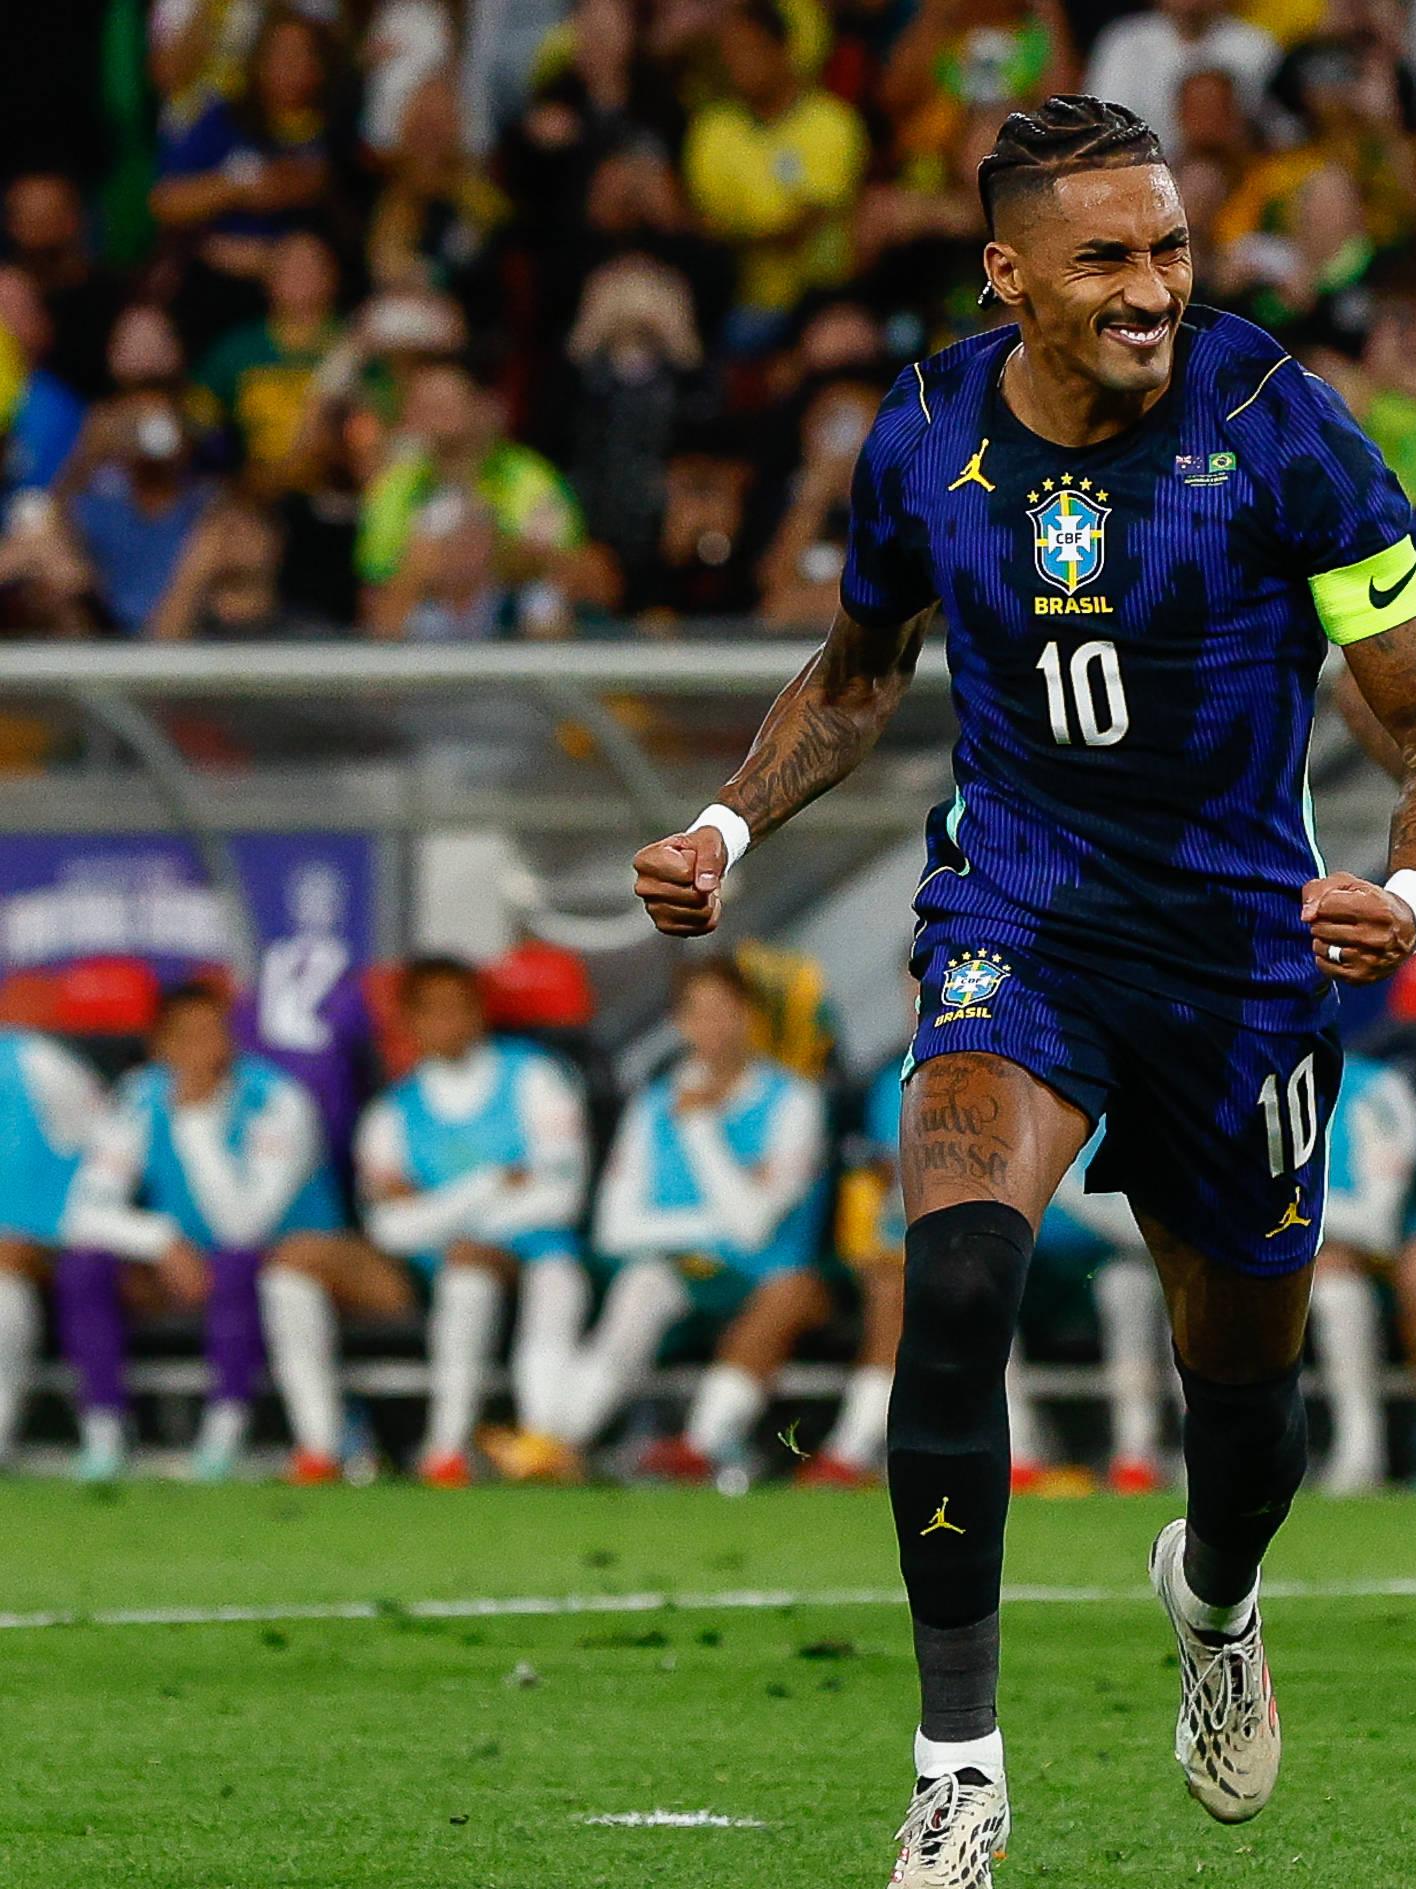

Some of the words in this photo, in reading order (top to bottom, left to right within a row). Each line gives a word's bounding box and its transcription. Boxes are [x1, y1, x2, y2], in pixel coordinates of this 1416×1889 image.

[1056, 532, 1083, 544] CBF
[1034, 596, 1114, 615] BRASIL
[1035, 640, 1129, 746] 10
[934, 1006, 992, 1028] BRASIL
[1256, 1051, 1317, 1179] 10
